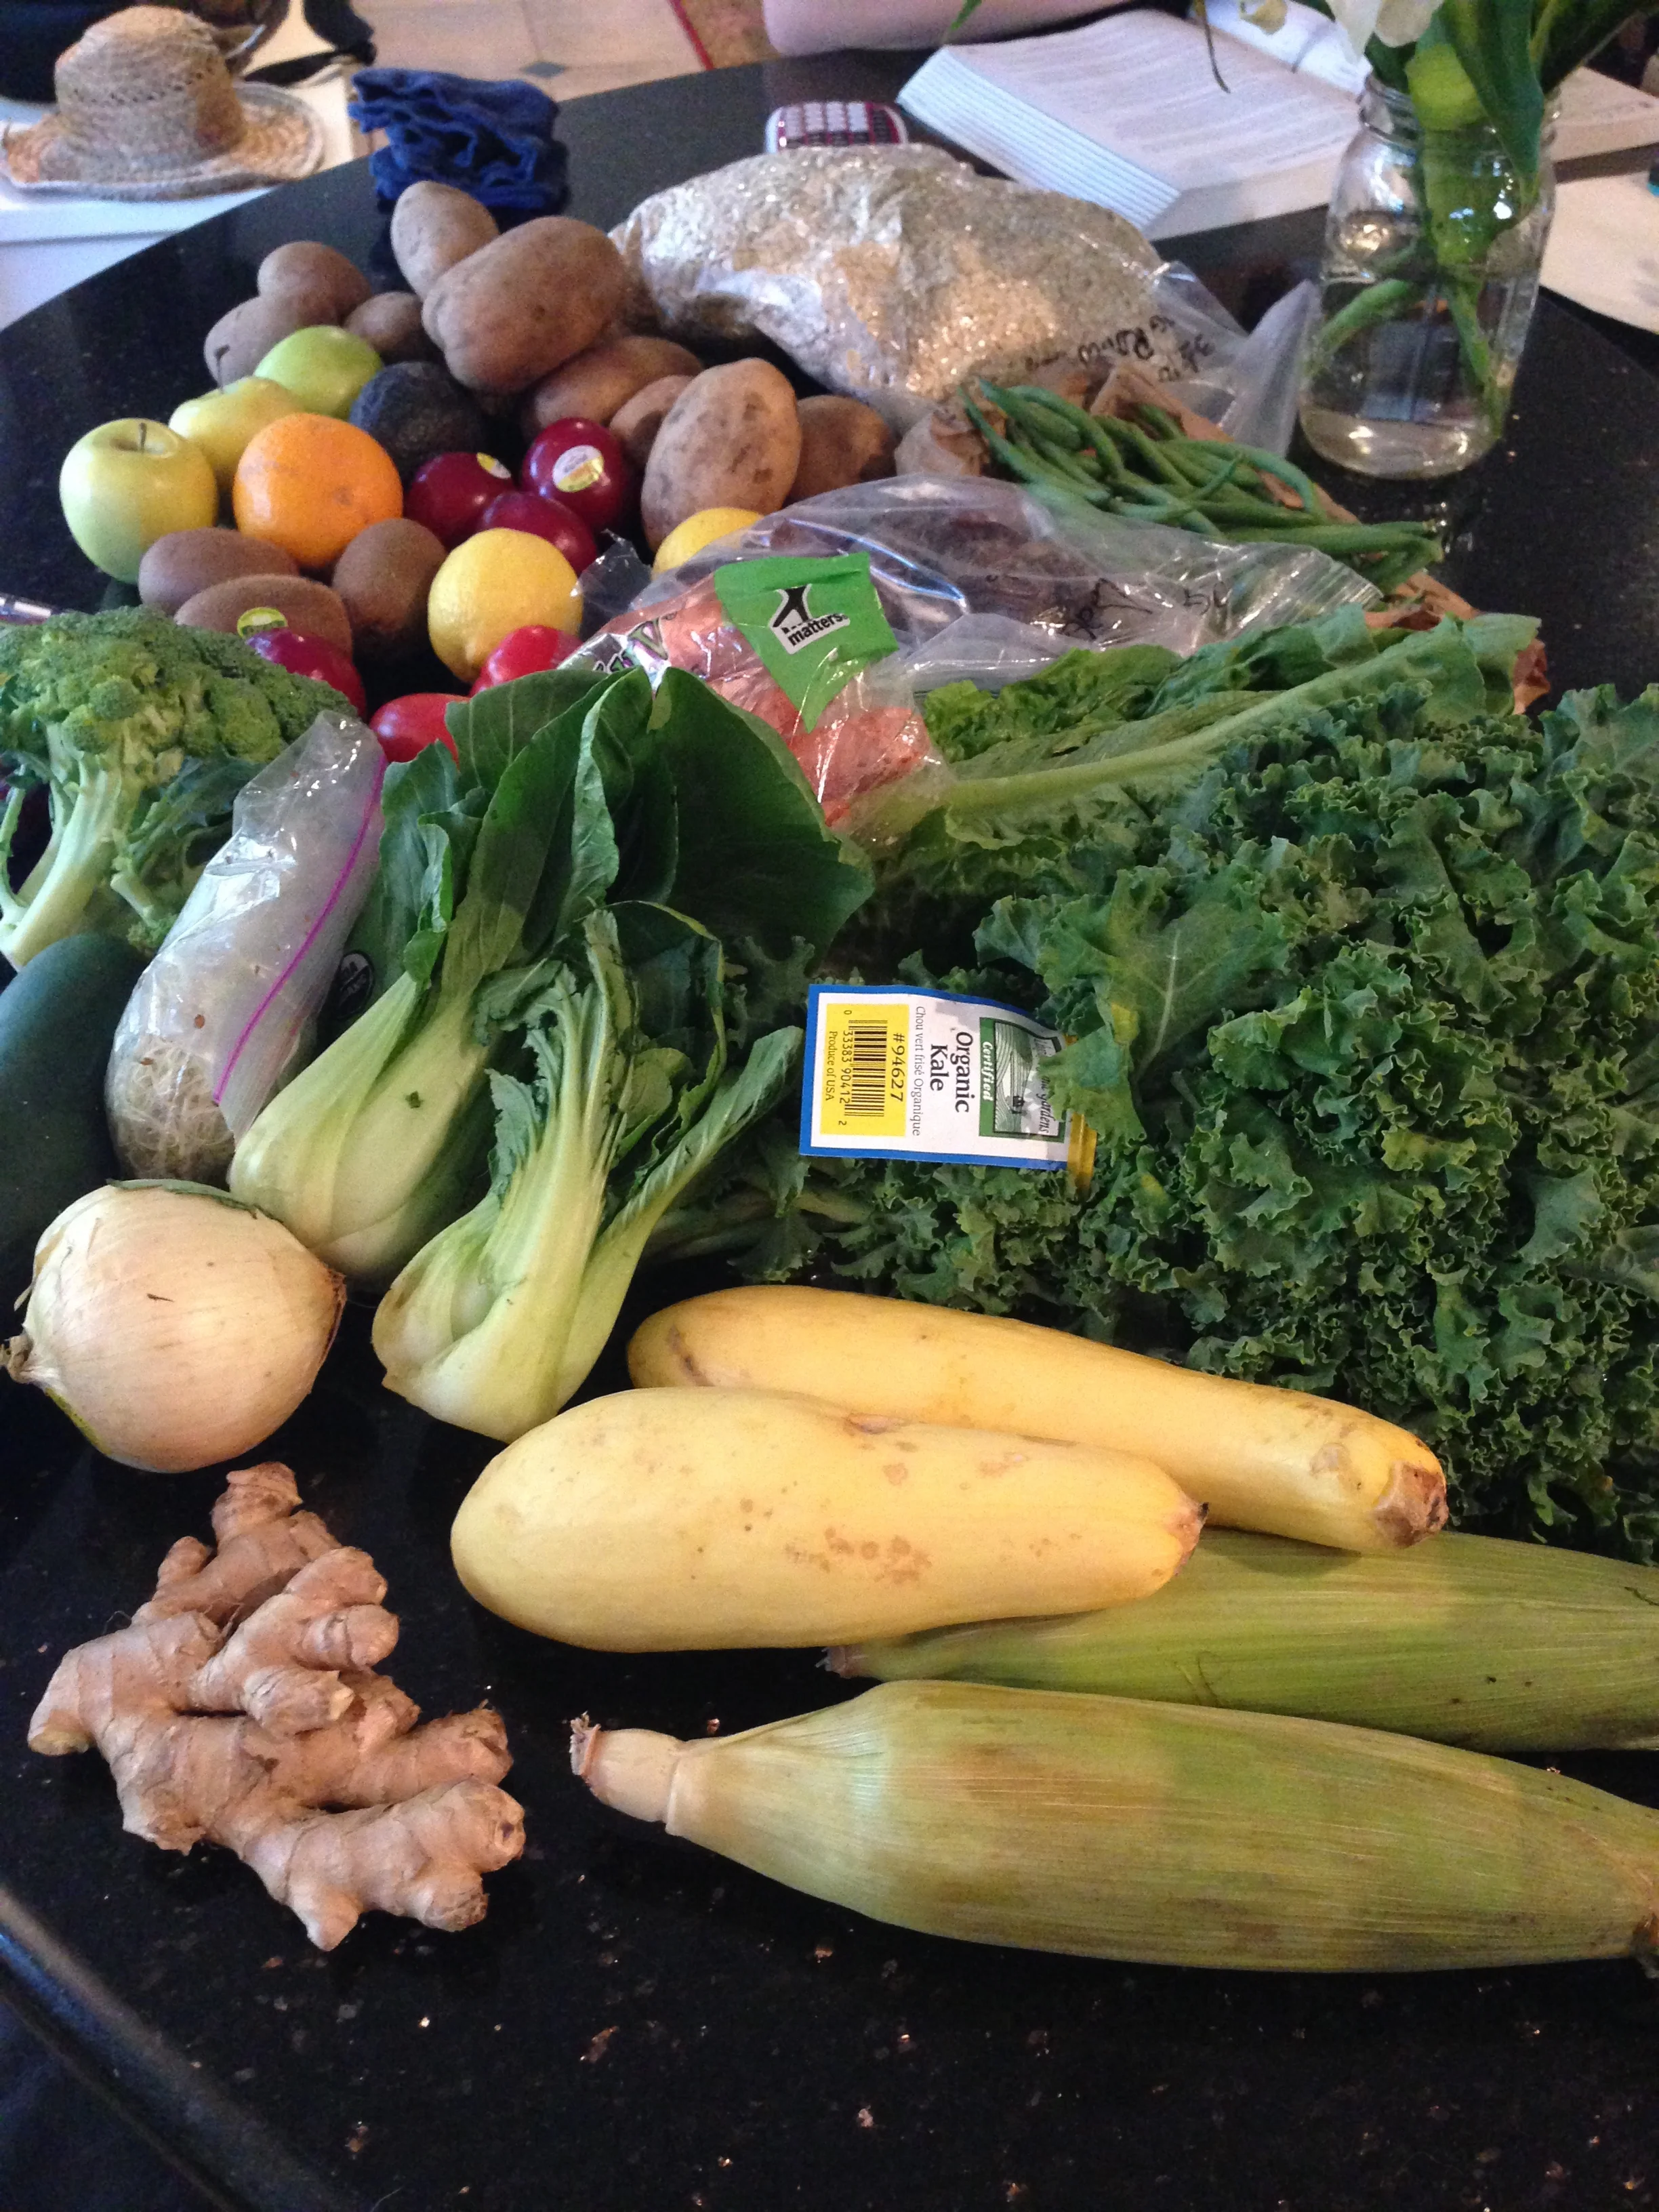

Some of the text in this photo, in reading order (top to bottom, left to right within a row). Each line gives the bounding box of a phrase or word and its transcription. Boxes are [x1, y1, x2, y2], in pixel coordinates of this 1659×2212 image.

[787, 613, 842, 646] matters
[825, 1031, 838, 1101] Produce of USA
[841, 1030, 853, 1063] 33383
[890, 1033, 905, 1102] #94627
[909, 1006, 926, 1136] Chou vert frisé Organique
[930, 1044, 949, 1091] Kale
[950, 1031, 975, 1113] Organic
[981, 1041, 994, 1101] Certified
[840, 1068, 852, 1104] 90412
